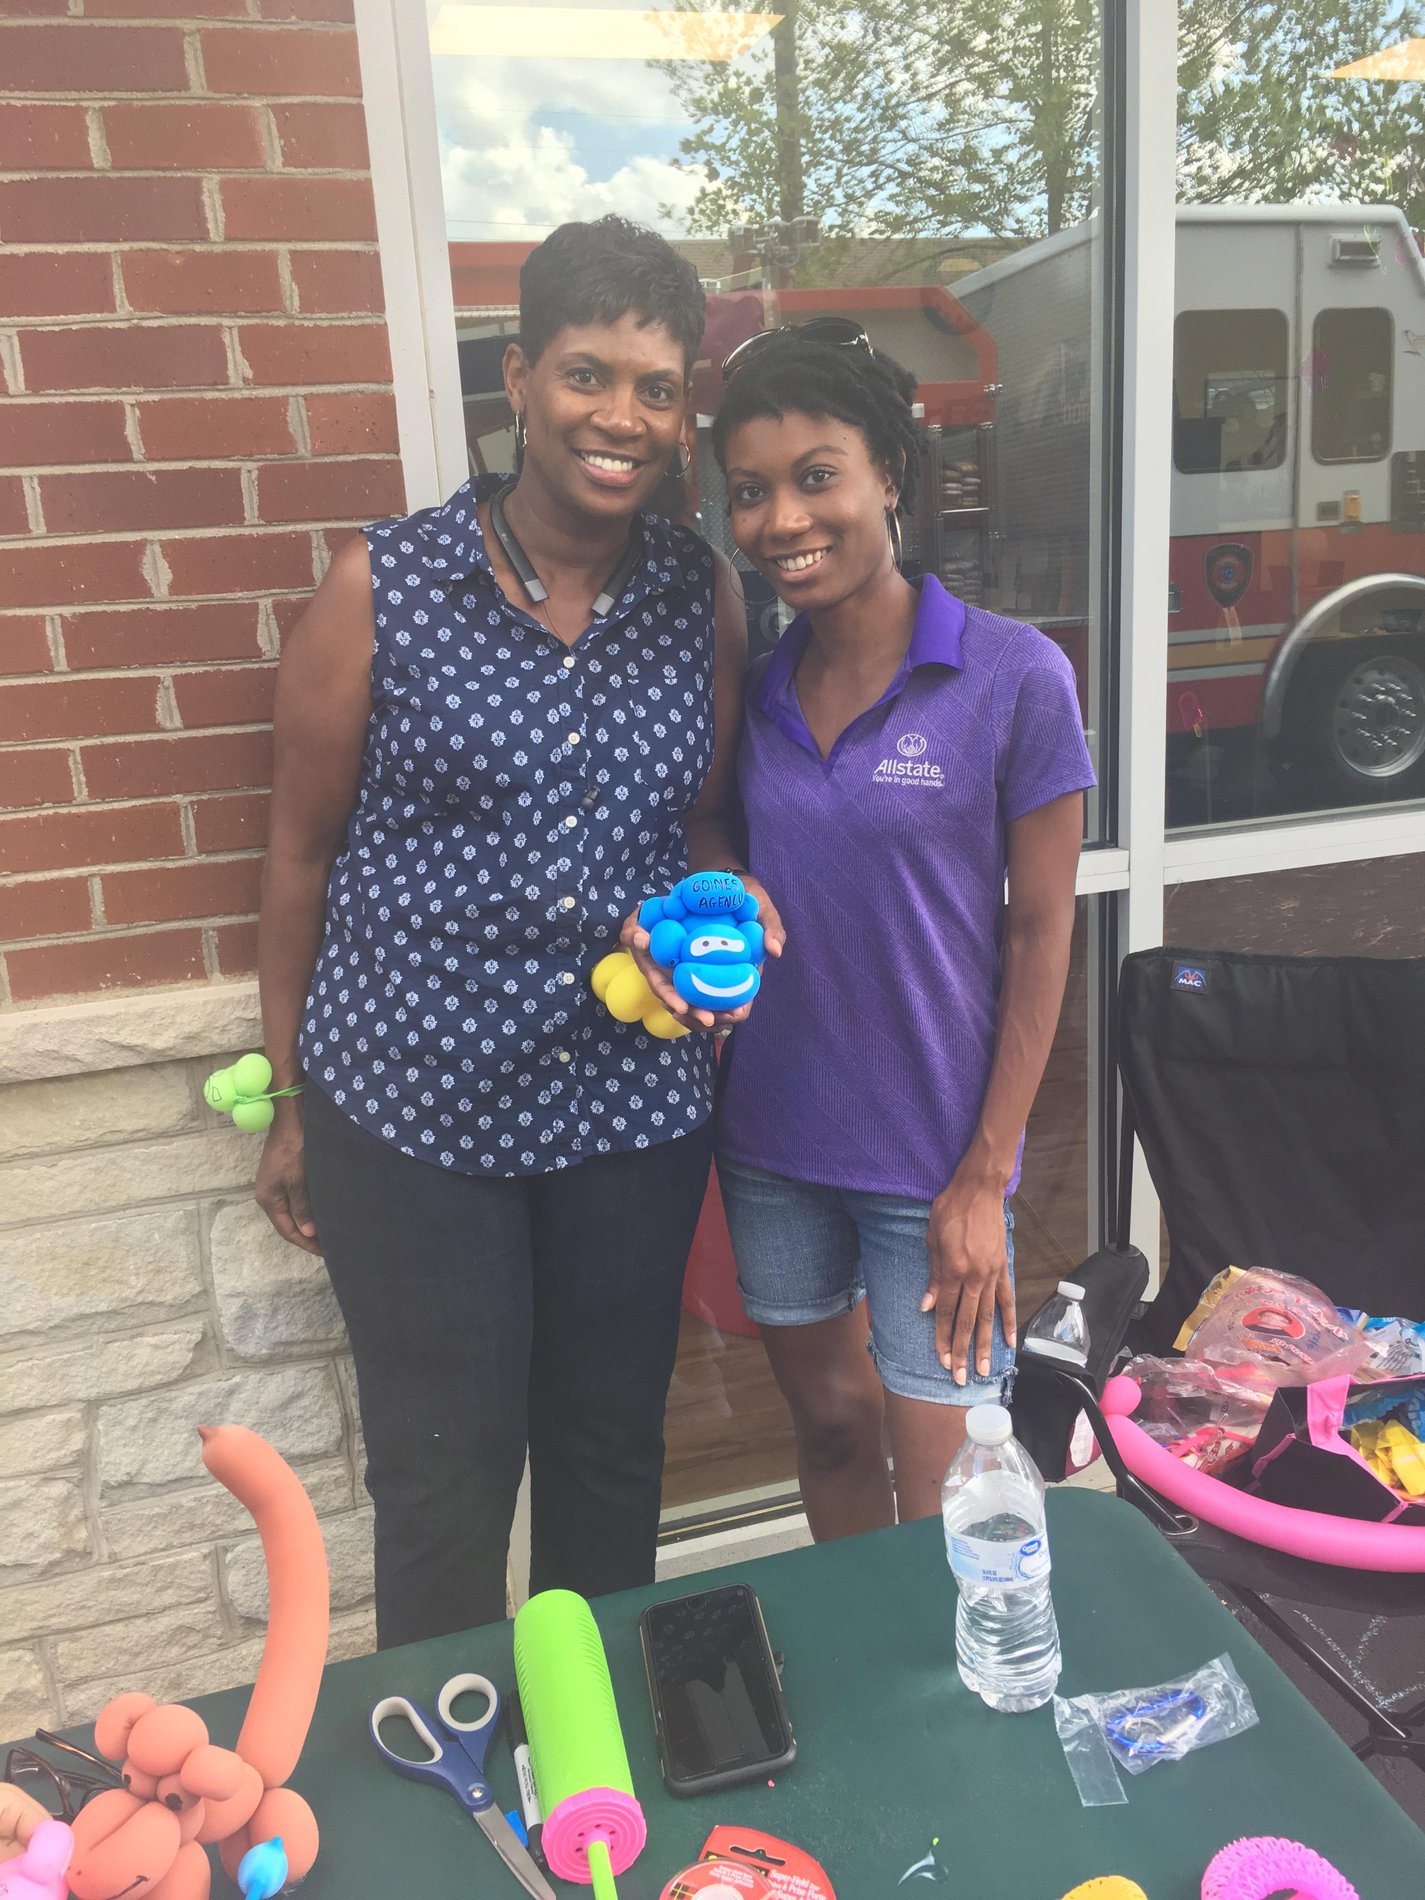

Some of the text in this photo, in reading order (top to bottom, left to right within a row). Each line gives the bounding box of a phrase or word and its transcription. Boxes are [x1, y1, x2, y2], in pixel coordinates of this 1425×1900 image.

[873, 759, 941, 778] Allstate
[872, 774, 893, 783] You're
[893, 776, 901, 784] in
[901, 778, 919, 786] good
[1178, 978, 1202, 987] MAC
